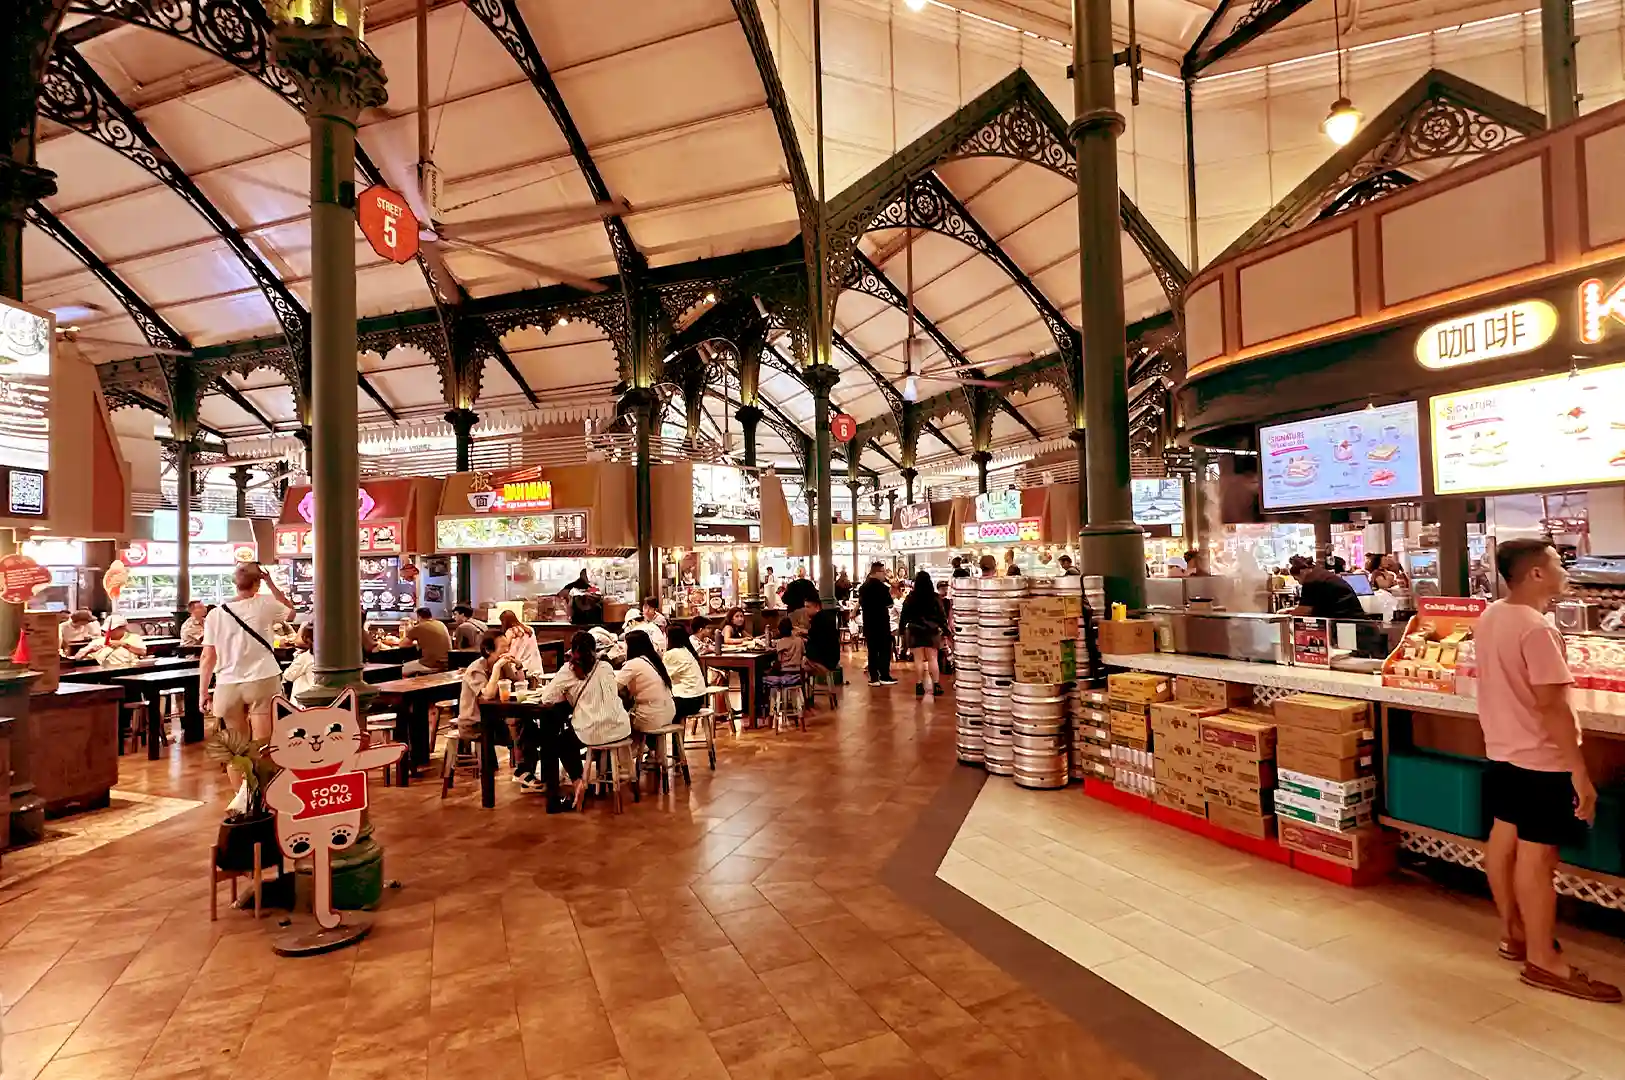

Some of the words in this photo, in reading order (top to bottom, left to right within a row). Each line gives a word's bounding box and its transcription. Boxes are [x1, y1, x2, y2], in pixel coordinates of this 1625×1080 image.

[376, 197, 403, 217] STREET
[384, 215, 397, 247] 5
[1437, 310, 1526, 360] 咖啡
[840, 424, 848, 437] 6
[1271, 431, 1305, 443] SIGNATURE
[1468, 603, 1480, 612] $2
[311, 784, 349, 798] FOOD
[310, 792, 352, 810] FOLKS
